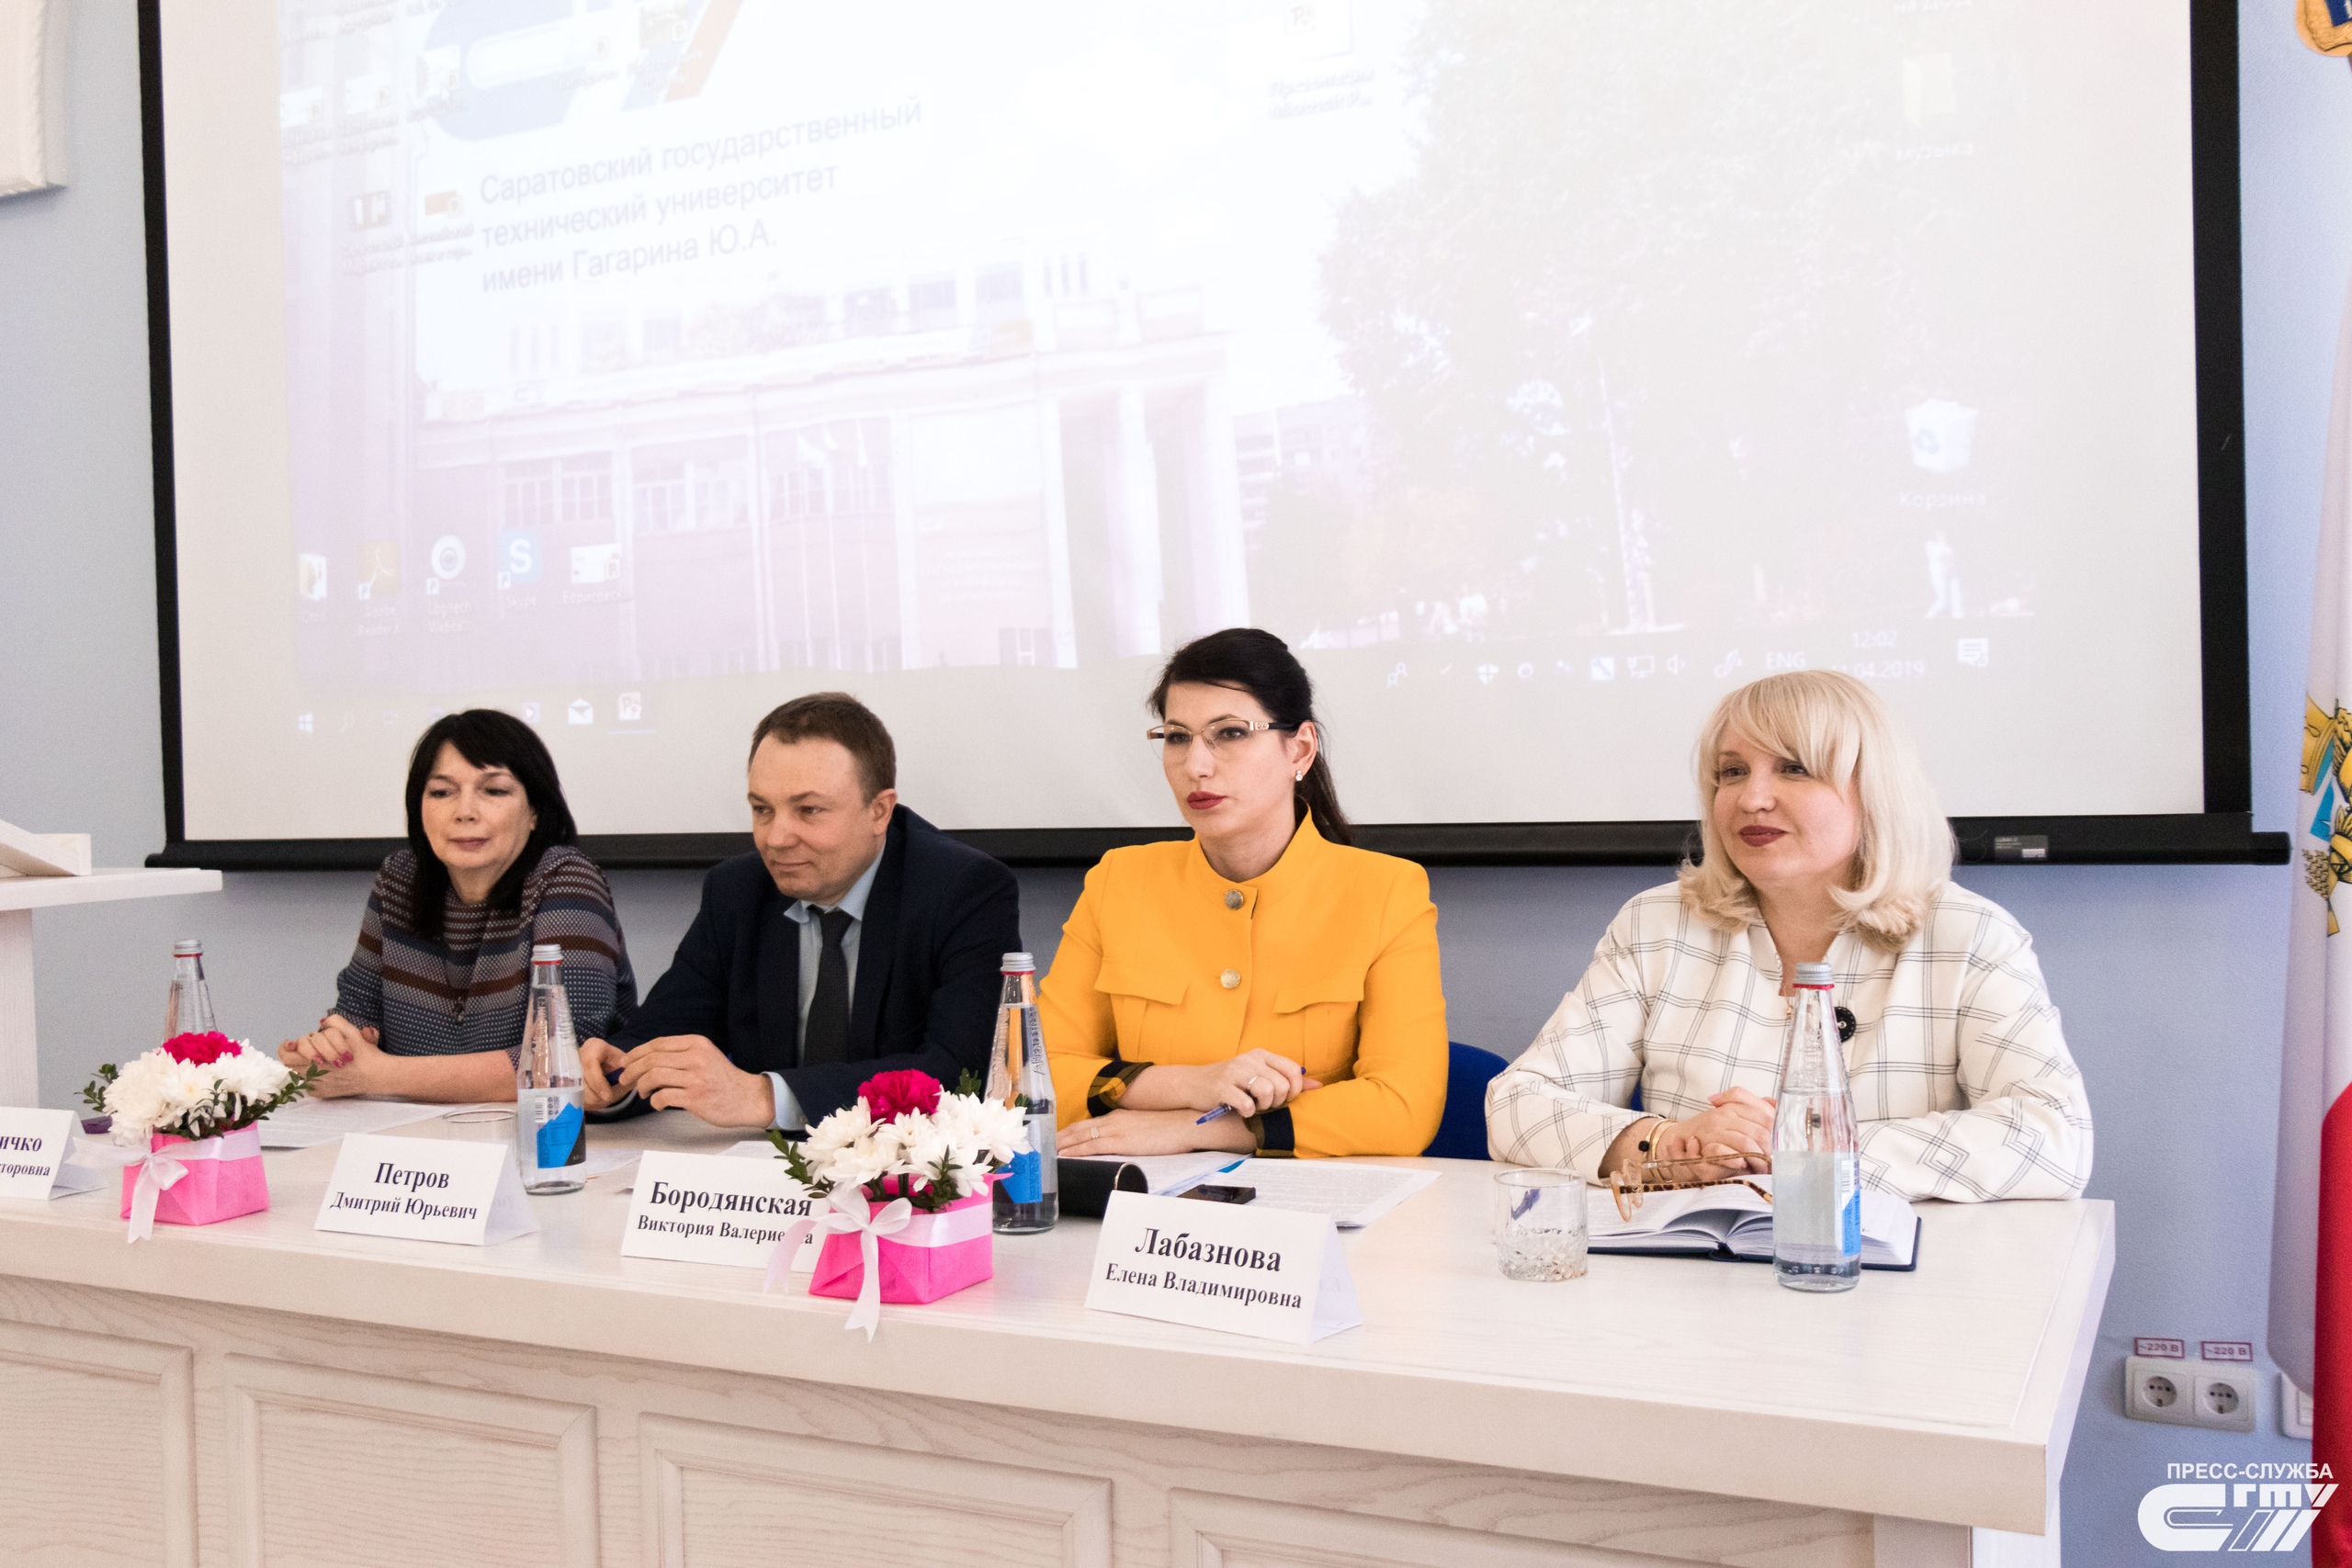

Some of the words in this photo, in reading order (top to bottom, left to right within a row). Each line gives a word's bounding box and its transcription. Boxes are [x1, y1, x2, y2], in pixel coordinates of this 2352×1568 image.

[481, 146, 652, 204] Саратовский
[662, 95, 922, 170] государственный
[482, 194, 646, 249] технический
[656, 164, 839, 225] университет
[482, 259, 563, 293] имени
[571, 237, 698, 279] Гагарина
[709, 218, 778, 255] Ю.А.
[1851, 630, 1899, 648] 12:02
[1765, 652, 1807, 670] ENG
[0, 1163, 51, 1178] торовна
[374, 1162, 450, 1192] Петров
[329, 1191, 401, 1215] Дмитрий
[404, 1198, 478, 1221] Юрьевич
[650, 1181, 812, 1216] Бородянская
[638, 1214, 715, 1237] Виктория
[719, 1222, 813, 1244] Валериеа
[1135, 1227, 1282, 1272] Лабазнова
[1105, 1263, 1158, 1287] Елена
[1163, 1271, 1302, 1309] Владимировна
